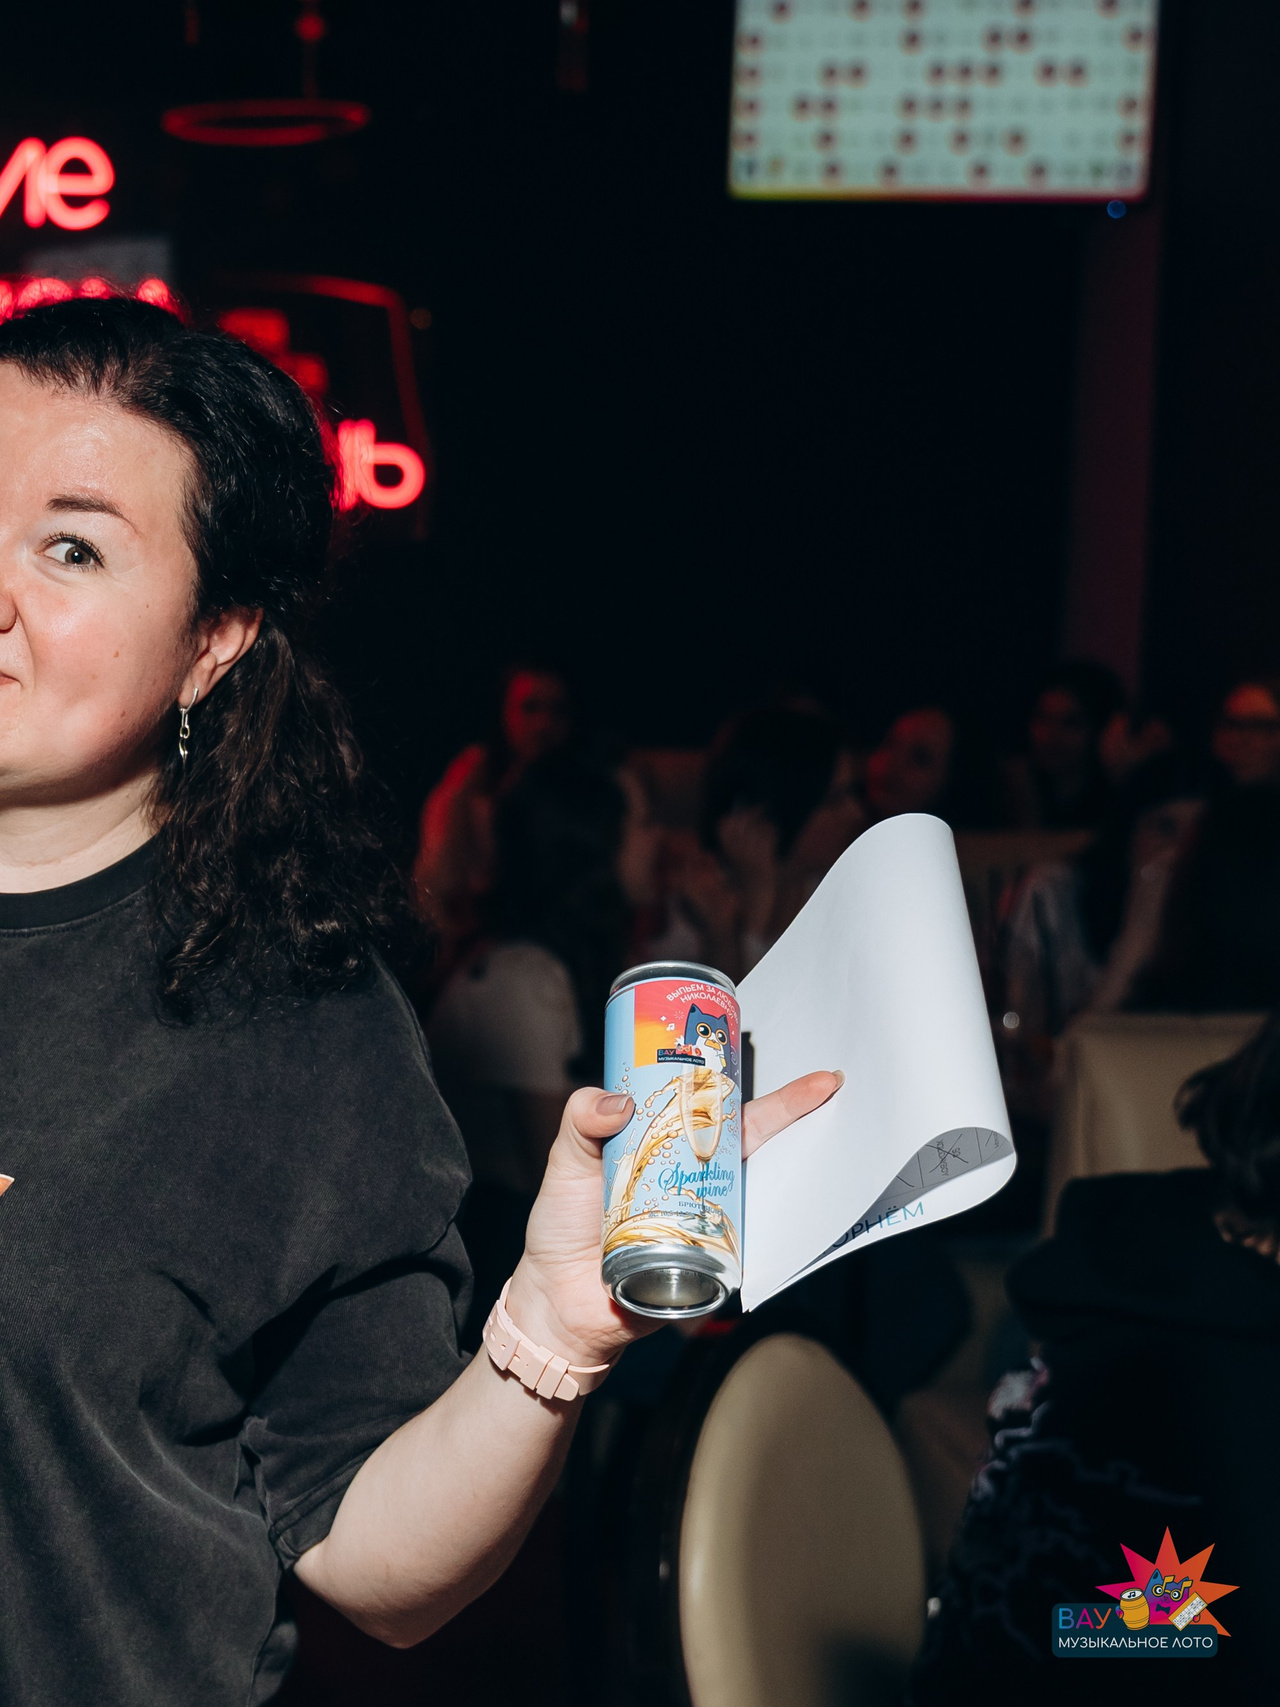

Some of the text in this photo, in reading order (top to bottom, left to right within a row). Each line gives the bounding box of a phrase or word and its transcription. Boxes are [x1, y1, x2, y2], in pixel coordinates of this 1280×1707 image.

[666, 983, 705, 1002] ВЫПЬЕМ
[706, 985, 716, 994] ЗА
[658, 1161, 735, 1196] Sparkling
[696, 1183, 728, 1198] wine
[824, 1201, 924, 1254] ОРНЁМ
